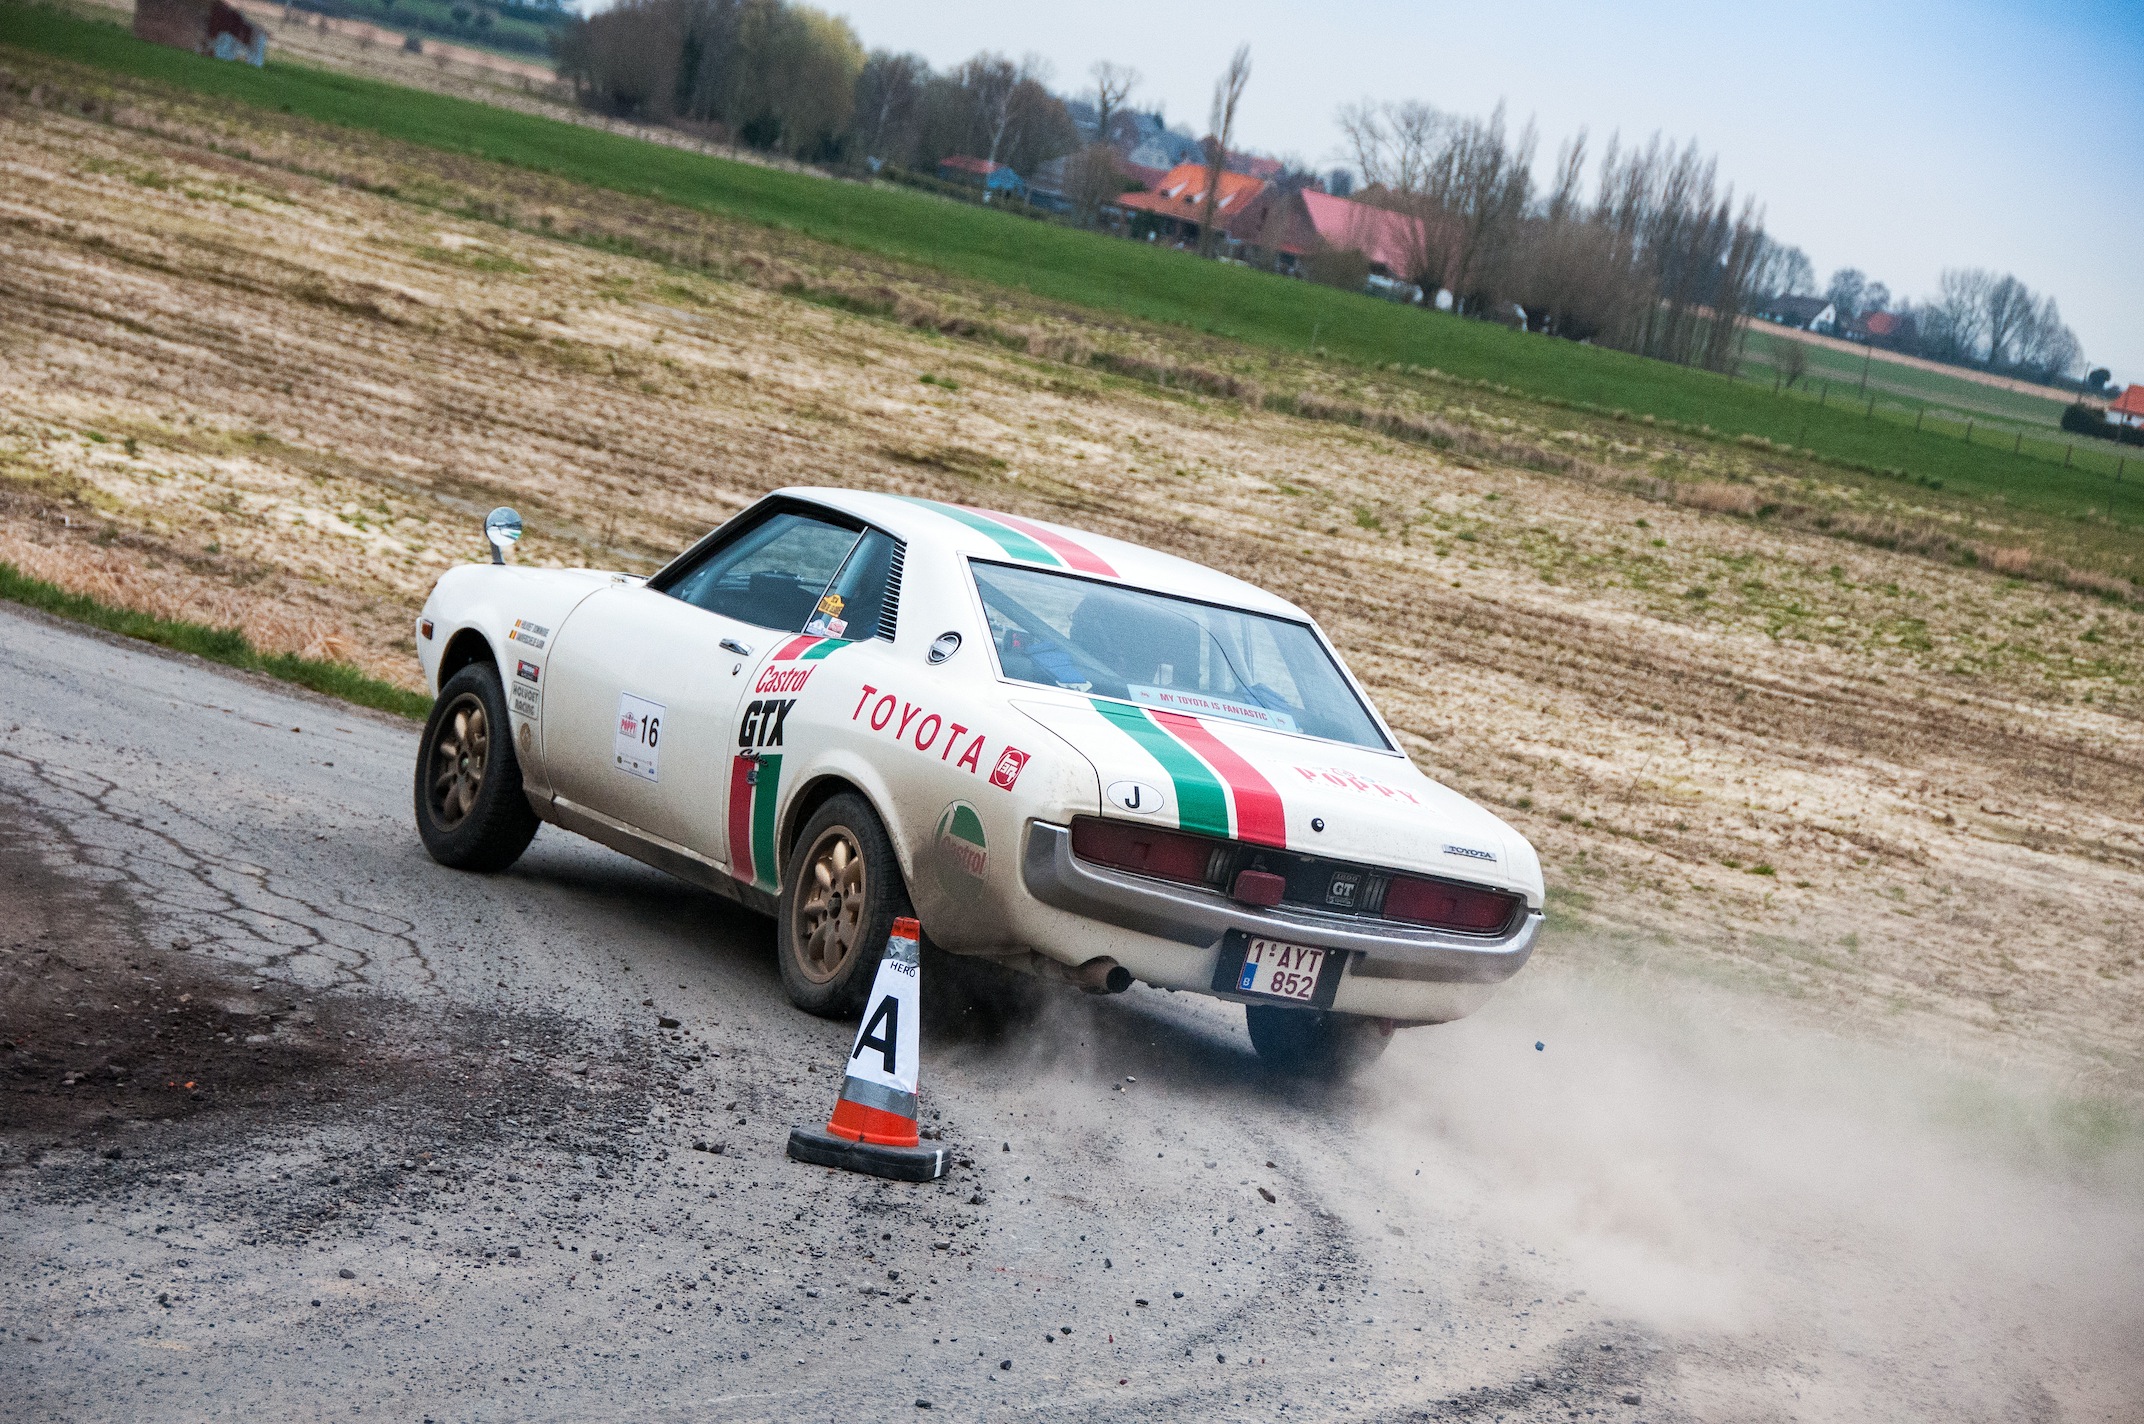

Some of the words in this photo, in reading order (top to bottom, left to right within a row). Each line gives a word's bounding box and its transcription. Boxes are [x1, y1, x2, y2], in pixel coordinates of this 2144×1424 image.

[755, 664, 817, 693] Castrol
[1159, 693, 1173, 702] MY
[1177, 695, 1209, 709] TOYOTA
[1211, 702, 1220, 710] IS
[1222, 704, 1268, 721] FANTASTIC
[620, 718, 637, 734] POPPY
[641, 714, 660, 748] 16
[738, 699, 797, 748] GTX
[852, 684, 986, 774] TOYOTA
[1124, 785, 1139, 809] J
[1292, 766, 1420, 804] POPPY
[1448, 845, 1493, 858] TOYOTA
[1332, 881, 1355, 897] GT
[890, 961, 916, 978] HERO
[1243, 977, 1250, 987] B
[1270, 971, 1314, 999] 852
[852, 994, 899, 1075] A
